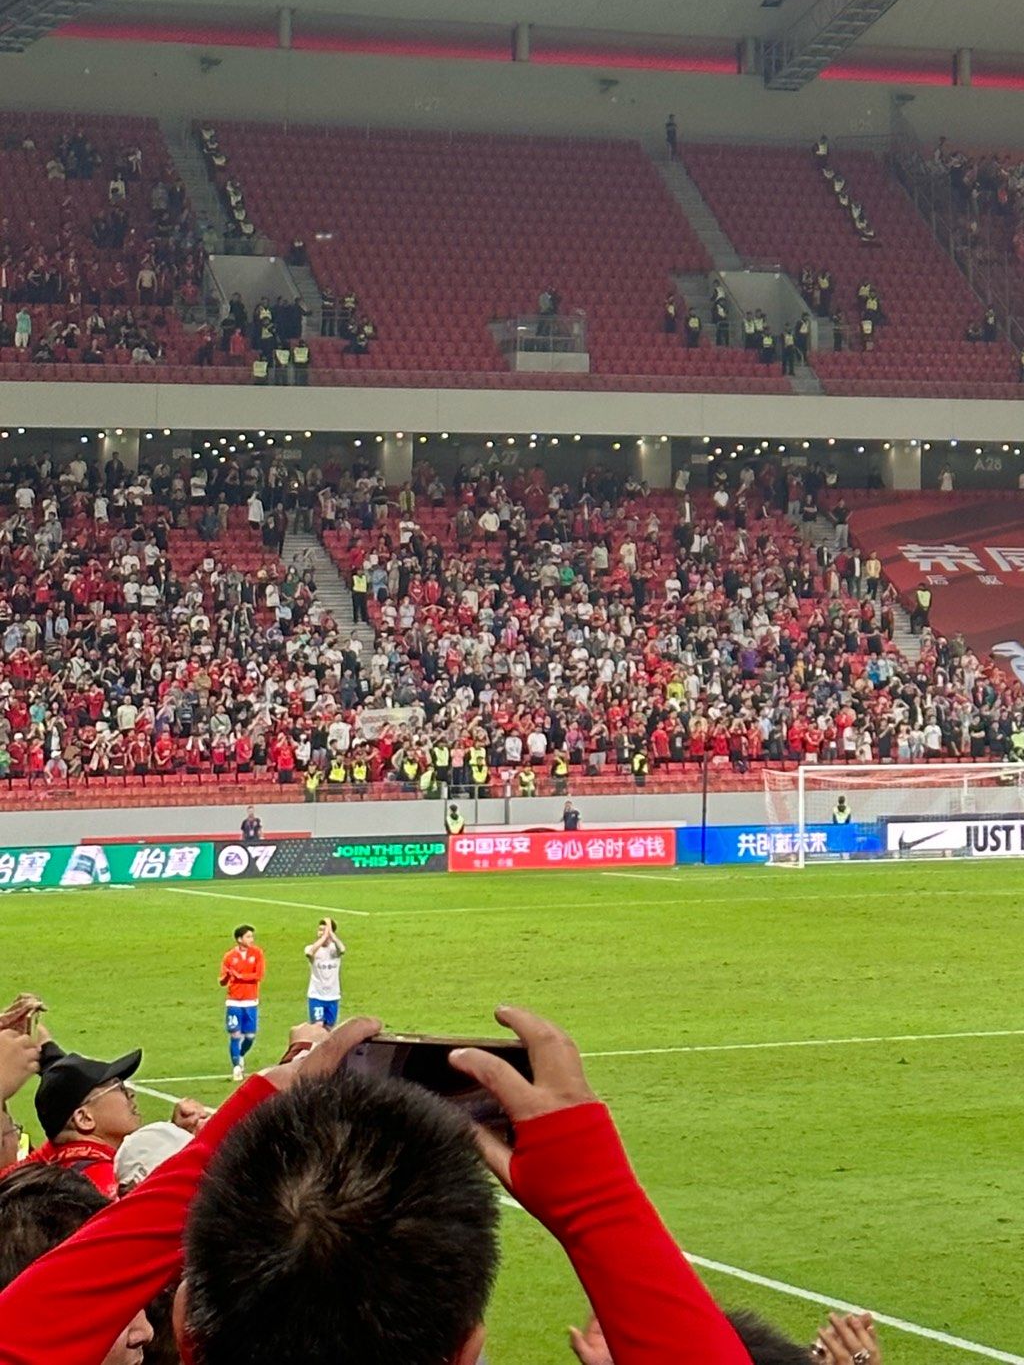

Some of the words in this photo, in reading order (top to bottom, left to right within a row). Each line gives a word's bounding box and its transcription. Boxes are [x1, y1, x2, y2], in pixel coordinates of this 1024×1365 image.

[966, 824, 1015, 851] JUST
[332, 845, 371, 858] JOIN
[372, 844, 406, 856] THE
[407, 842, 446, 855] CLUB
[455, 836, 531, 855] 中国平安
[544, 838, 584, 861] 省心
[586, 837, 625, 860] 省时
[351, 856, 388, 868] THIS
[389, 854, 431, 867] JULY
